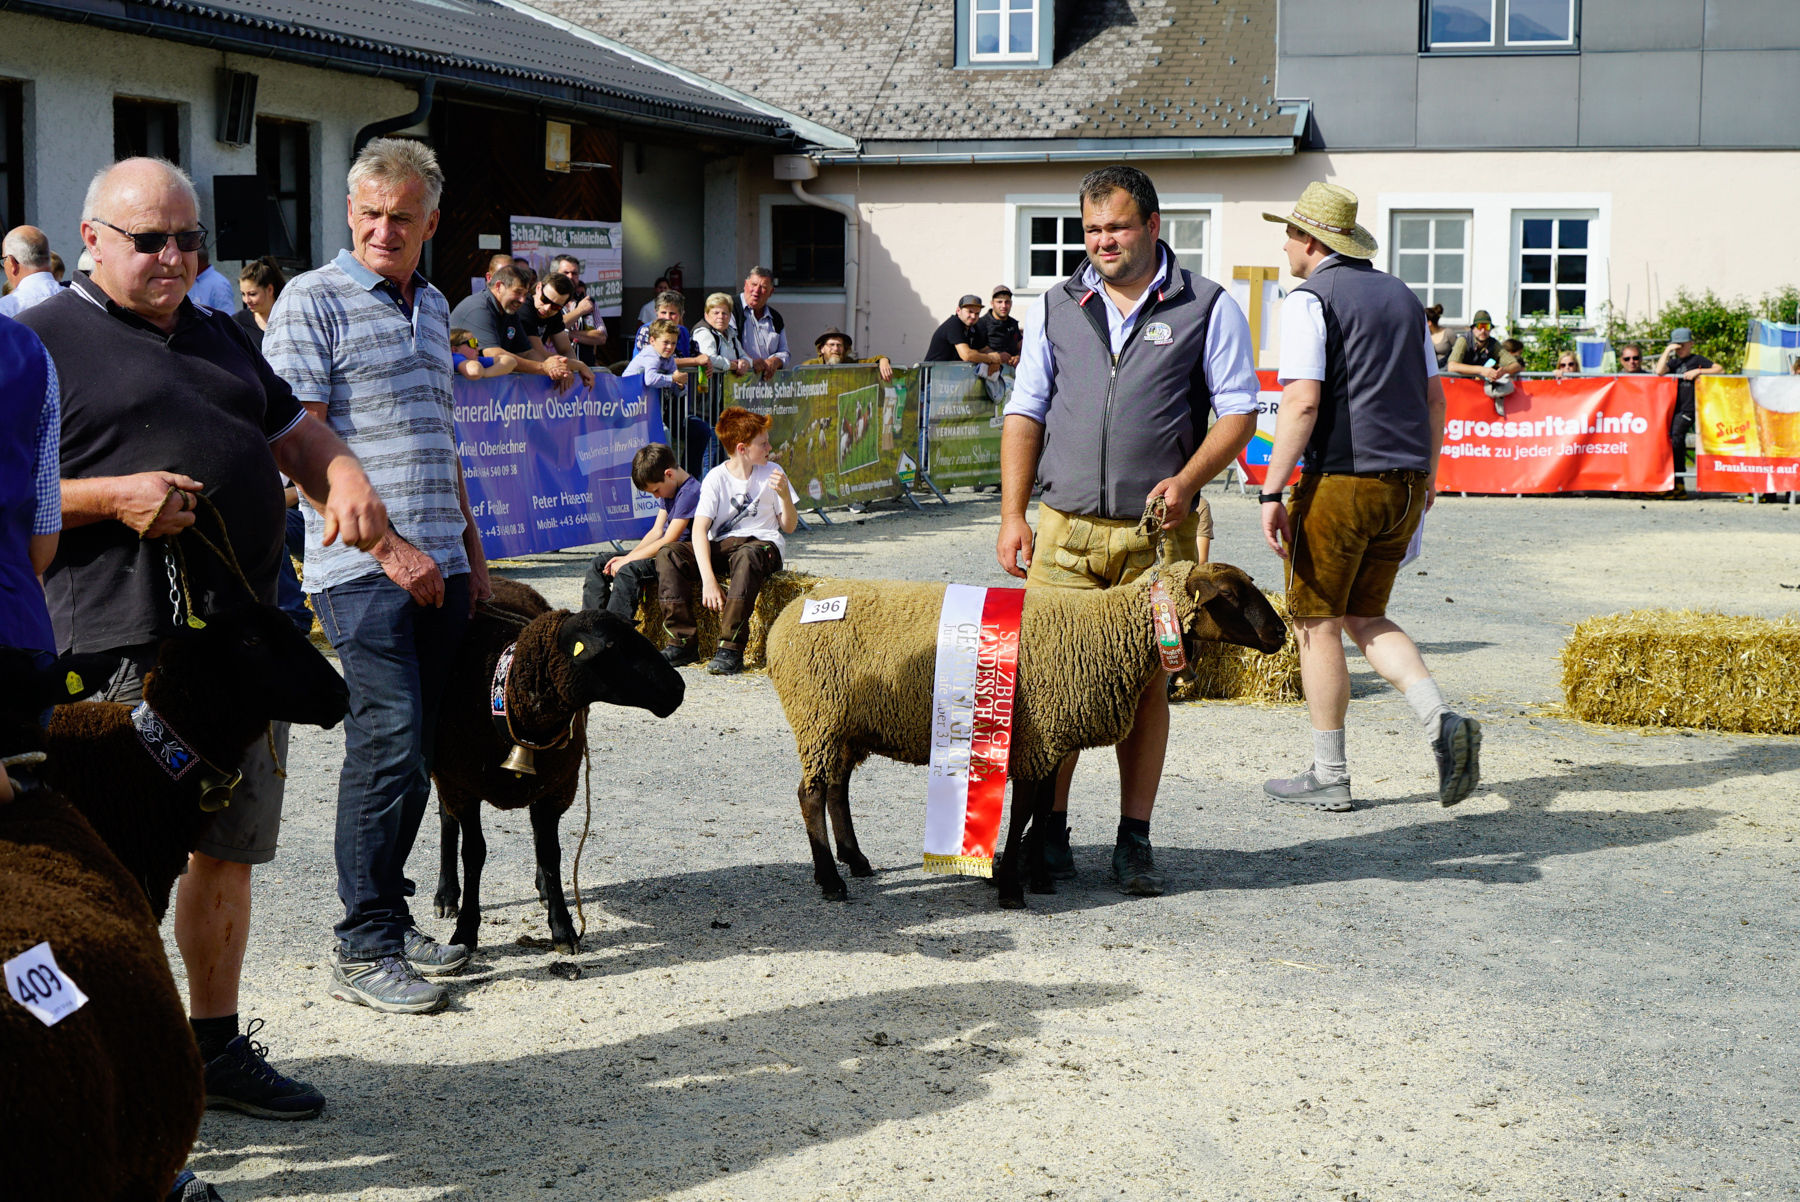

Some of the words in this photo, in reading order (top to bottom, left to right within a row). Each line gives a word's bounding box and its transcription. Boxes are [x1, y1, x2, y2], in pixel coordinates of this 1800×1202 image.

[511, 223, 568, 247] SchaZie-Tag
[569, 231, 609, 245] Feldkirchen
[935, 425, 980, 437] VERMARKTUNG
[1444, 411, 1648, 441] .grossarltal.info
[480, 439, 526, 457] Oberlechner
[1494, 447, 1511, 458] zu
[1513, 443, 1552, 461] jeder
[1556, 441, 1629, 457] Jahreszeit
[1713, 460, 1774, 474] Braukunst
[1776, 463, 1798, 474] auf
[532, 493, 558, 510] Peter
[634, 500, 661, 512] UNIQA
[811, 600, 841, 615] 396
[973, 623, 999, 744] LANDESSCHAU
[946, 622, 978, 778] GESAMTSIEGERIN
[989, 631, 1018, 774] SALZBURGER
[937, 730, 949, 738] 3
[969, 750, 989, 783] 2024
[17, 964, 62, 1004] 409
